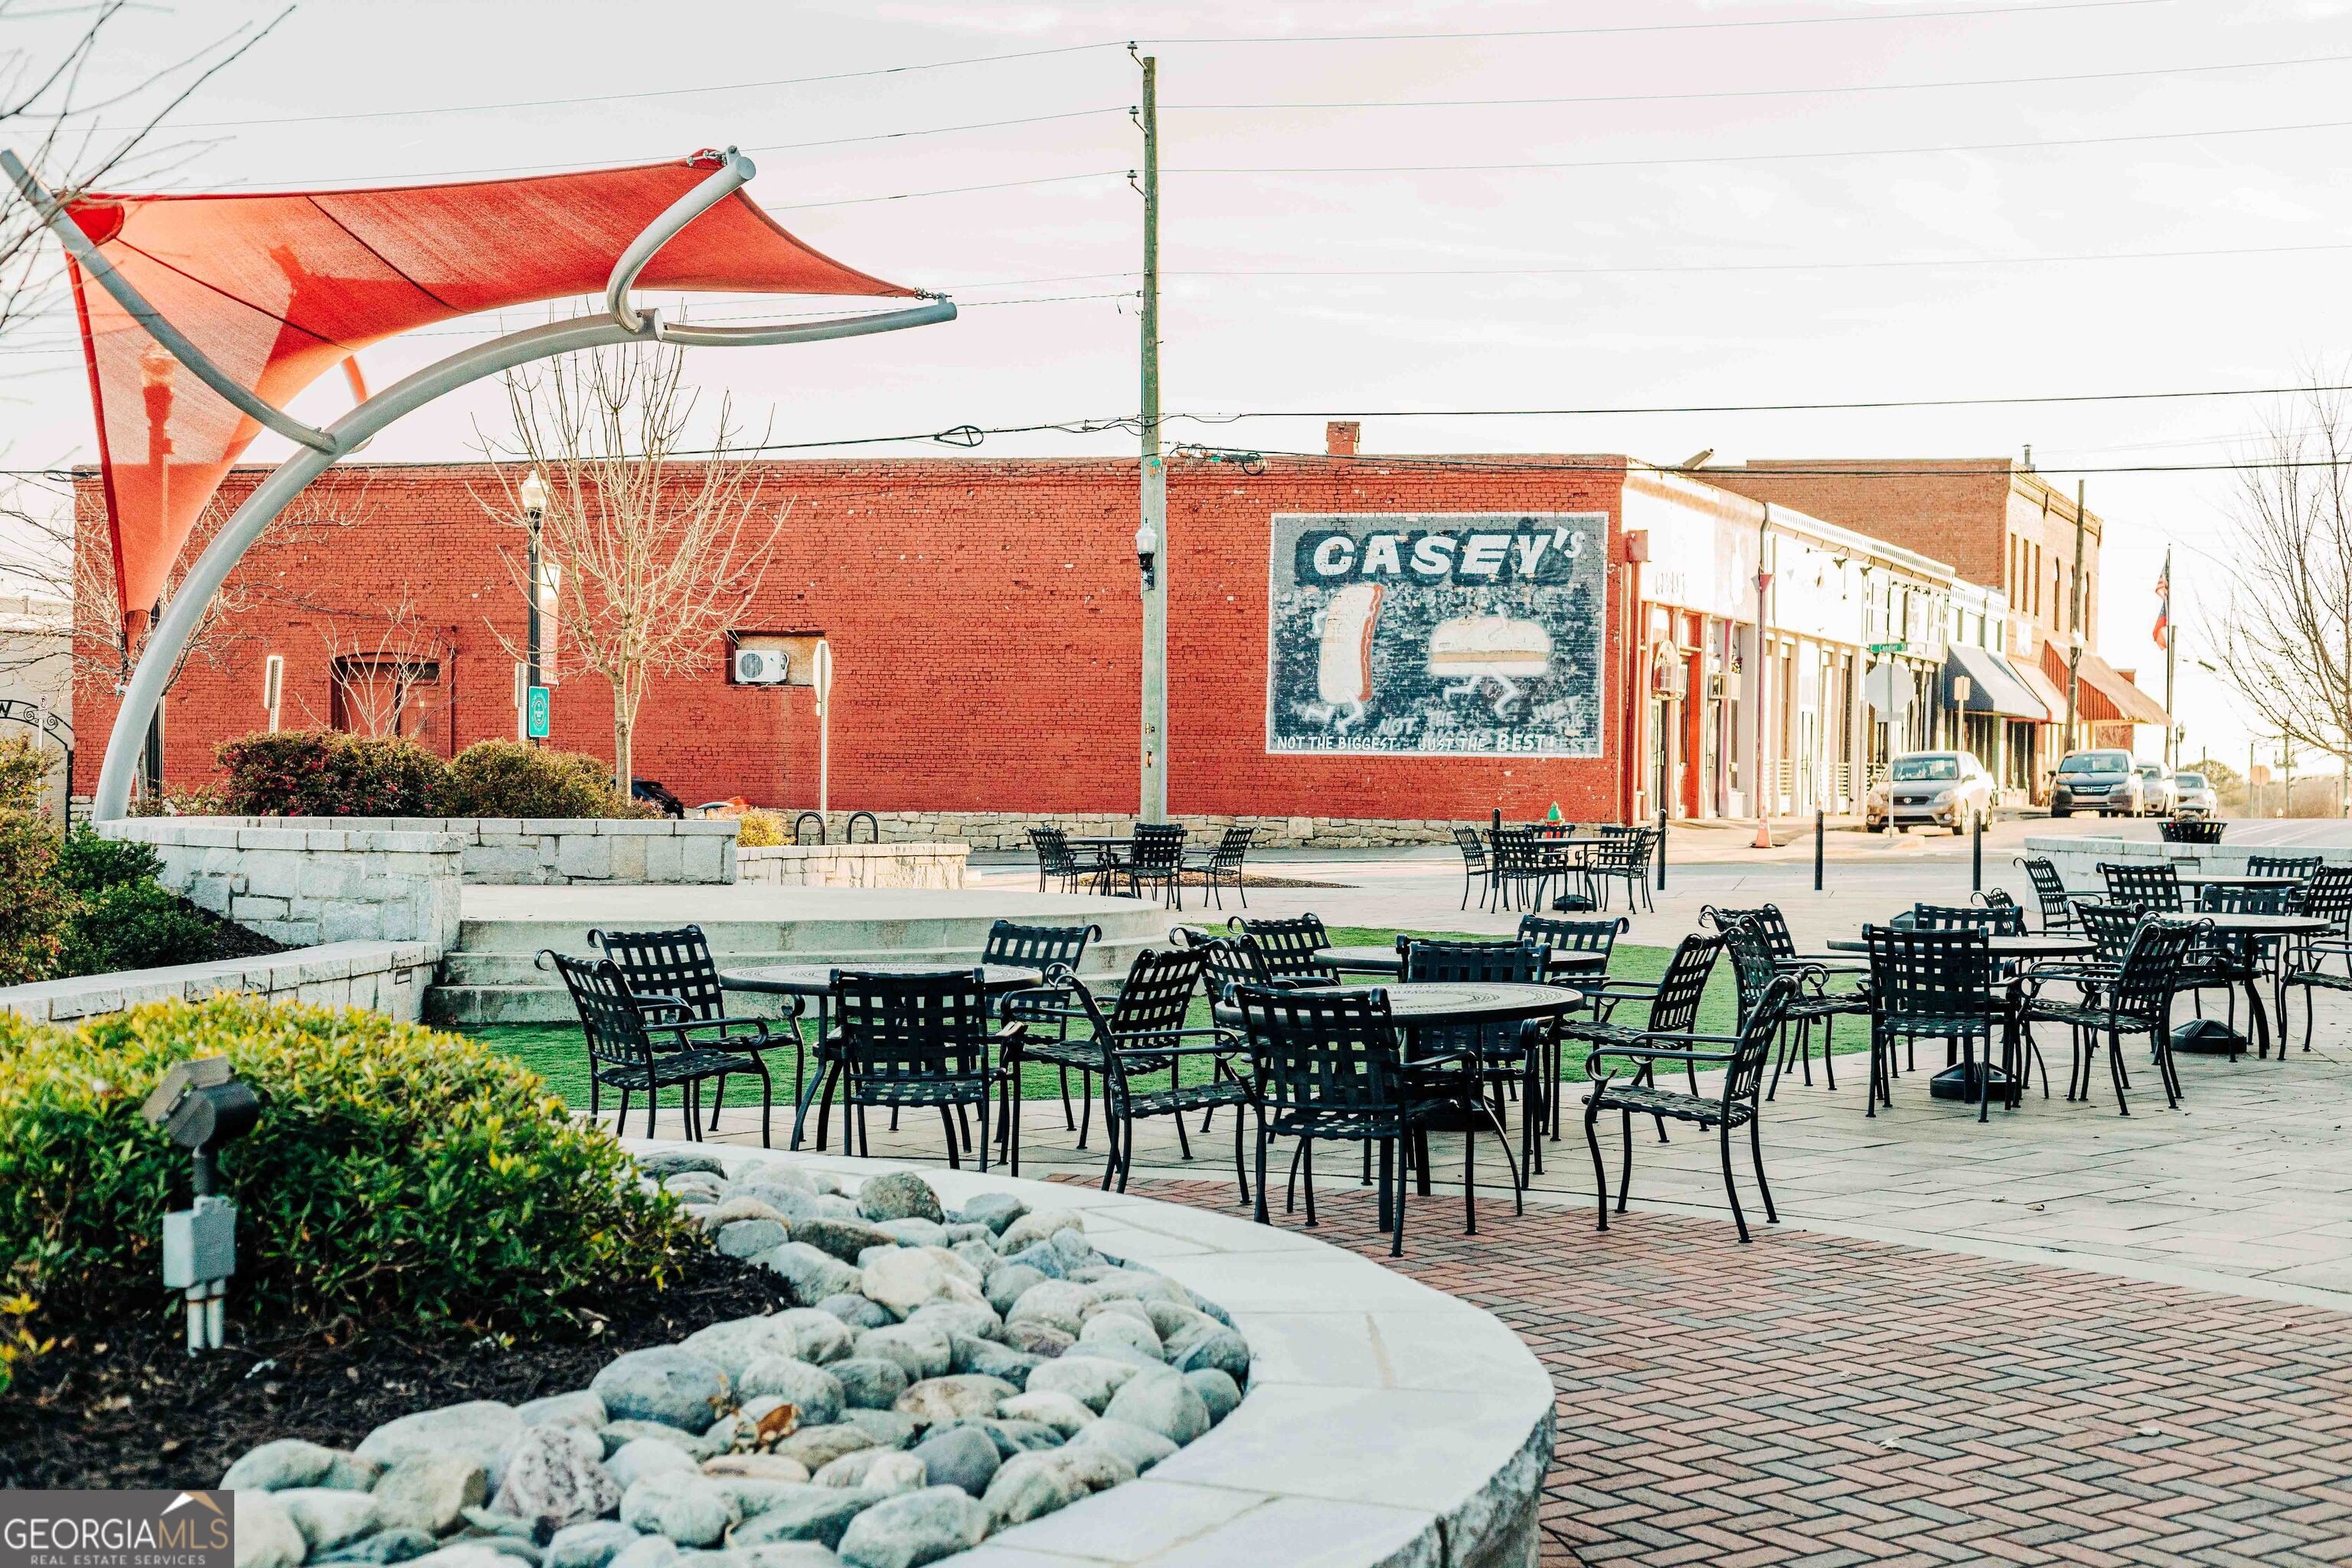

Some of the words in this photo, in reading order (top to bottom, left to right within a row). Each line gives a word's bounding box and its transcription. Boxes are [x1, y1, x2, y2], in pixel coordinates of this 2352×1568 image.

[1276, 736, 1305, 750] NOT
[1308, 736, 1334, 750] THE
[1417, 737, 1455, 752] JUST
[1458, 737, 1487, 752] THE
